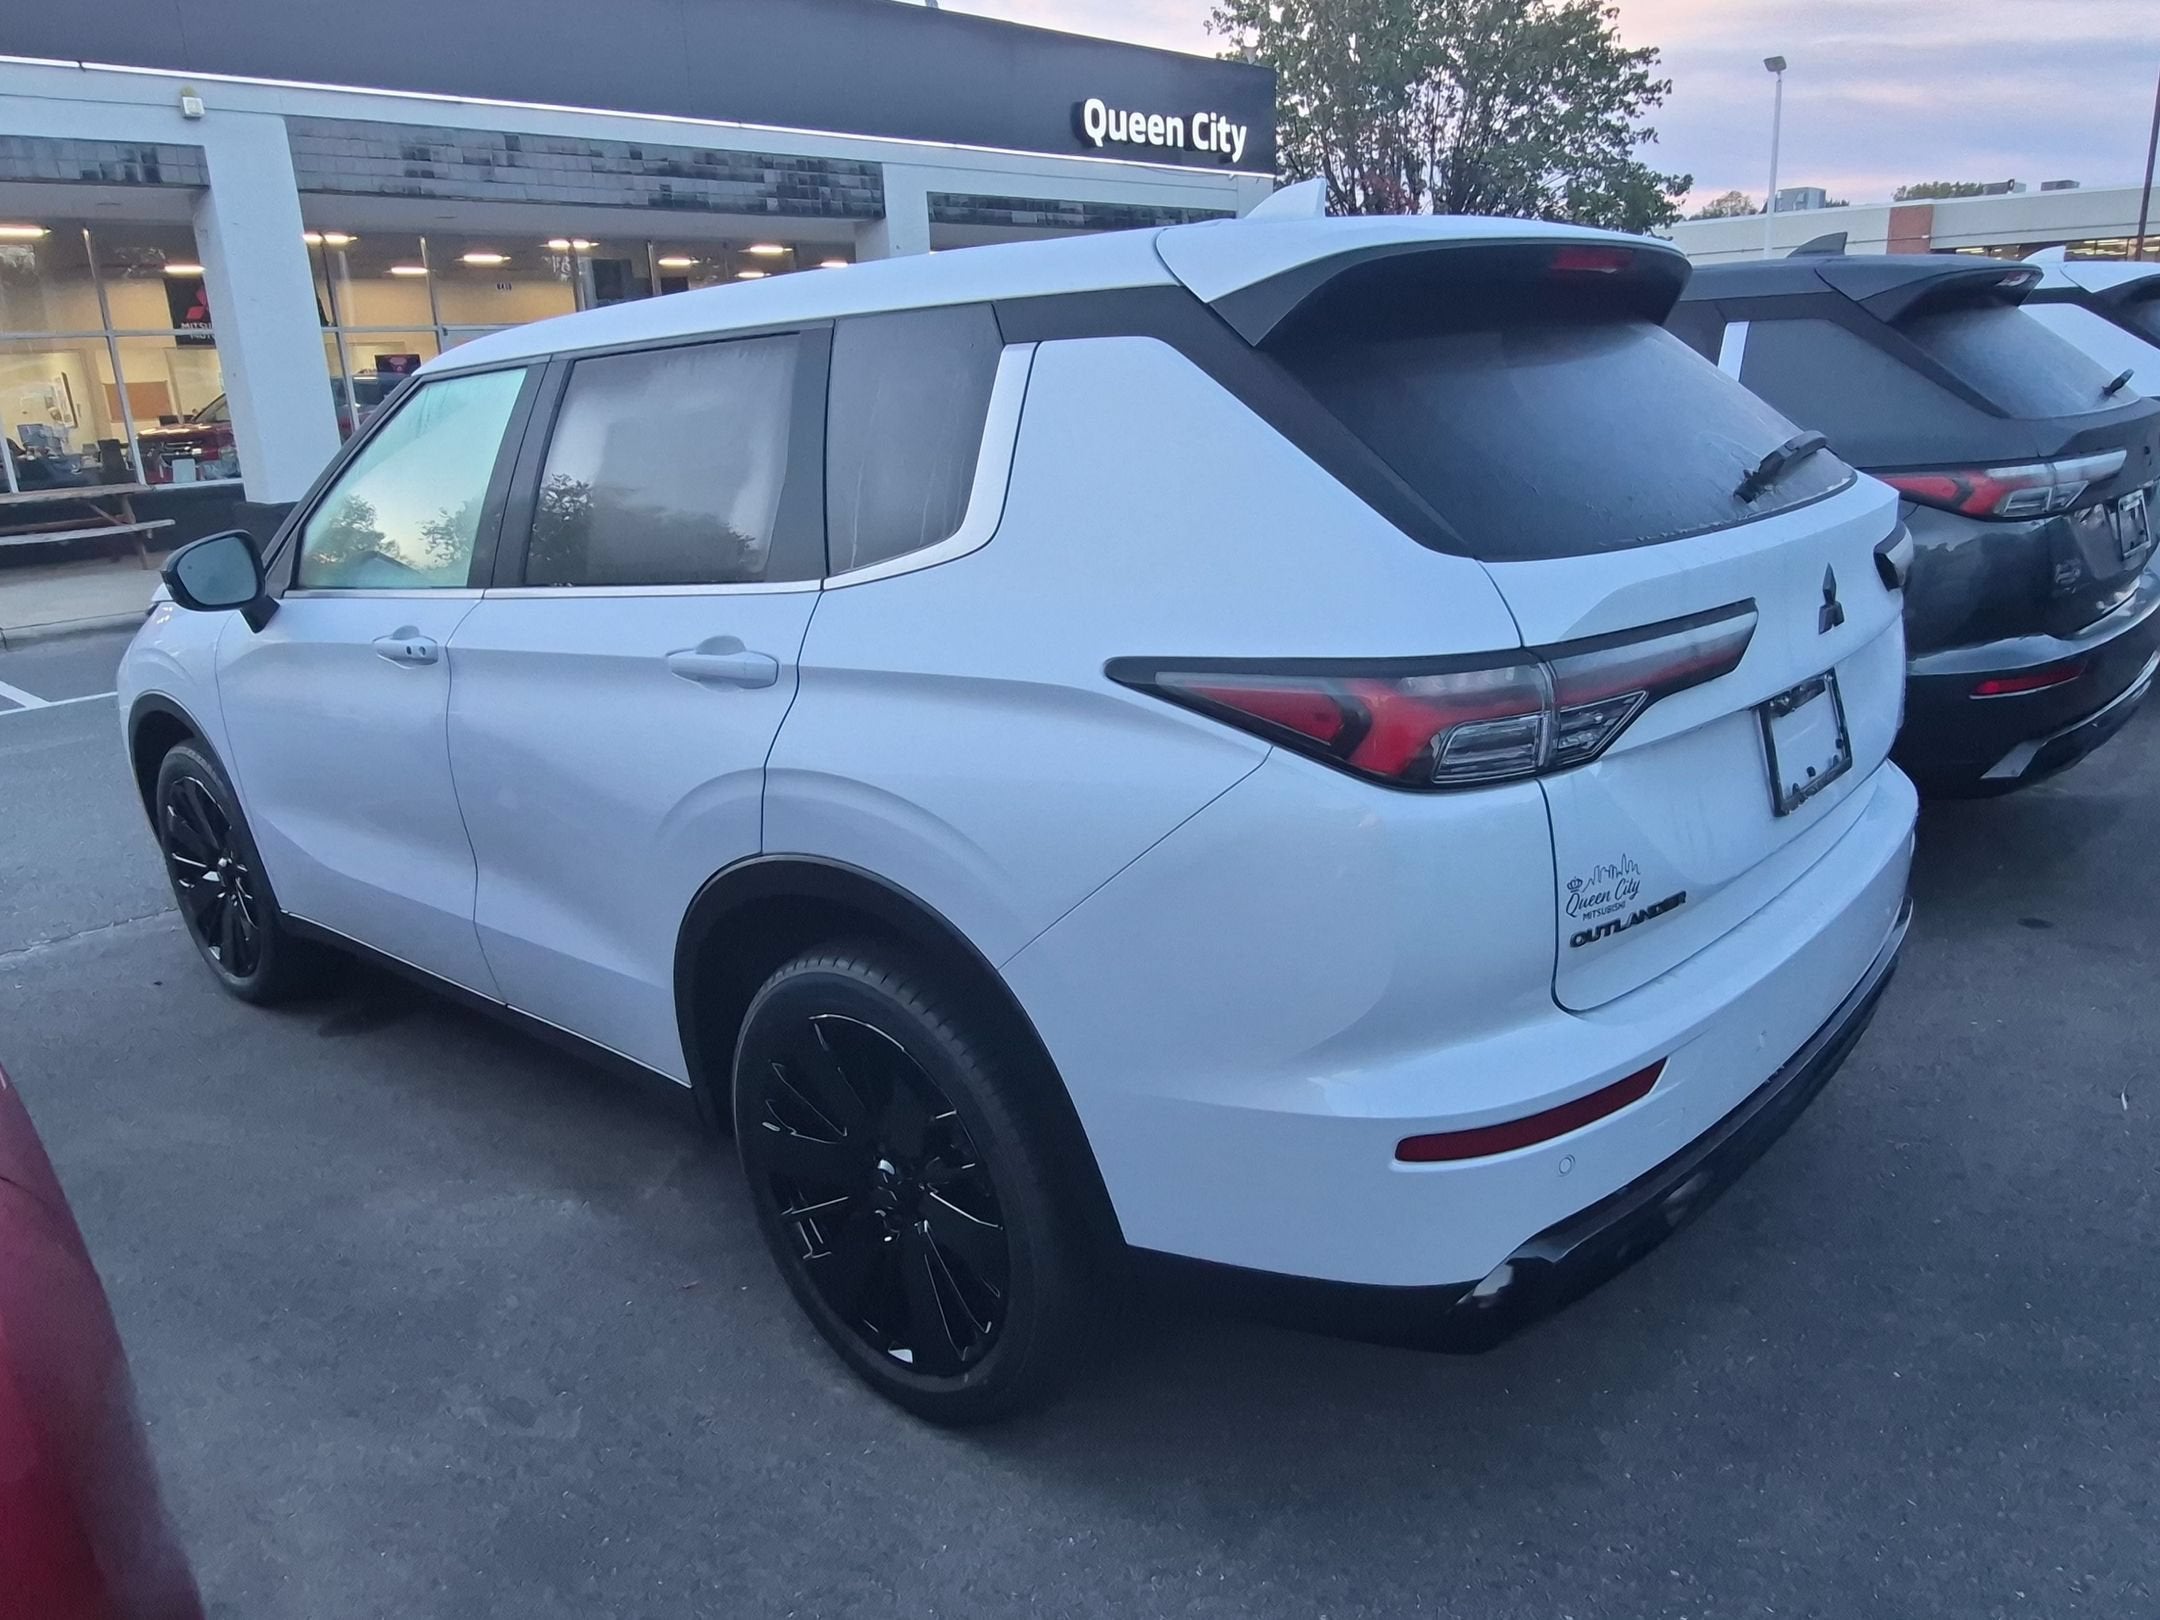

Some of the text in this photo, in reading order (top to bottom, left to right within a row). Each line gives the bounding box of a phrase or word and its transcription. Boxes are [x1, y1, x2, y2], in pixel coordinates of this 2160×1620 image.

[1083, 98, 1247, 163] Queen City
[1566, 878, 1641, 918] Queen City
[1569, 890, 1687, 948] OUTLANDER
[1582, 901, 1626, 921] MITSUBISHI
